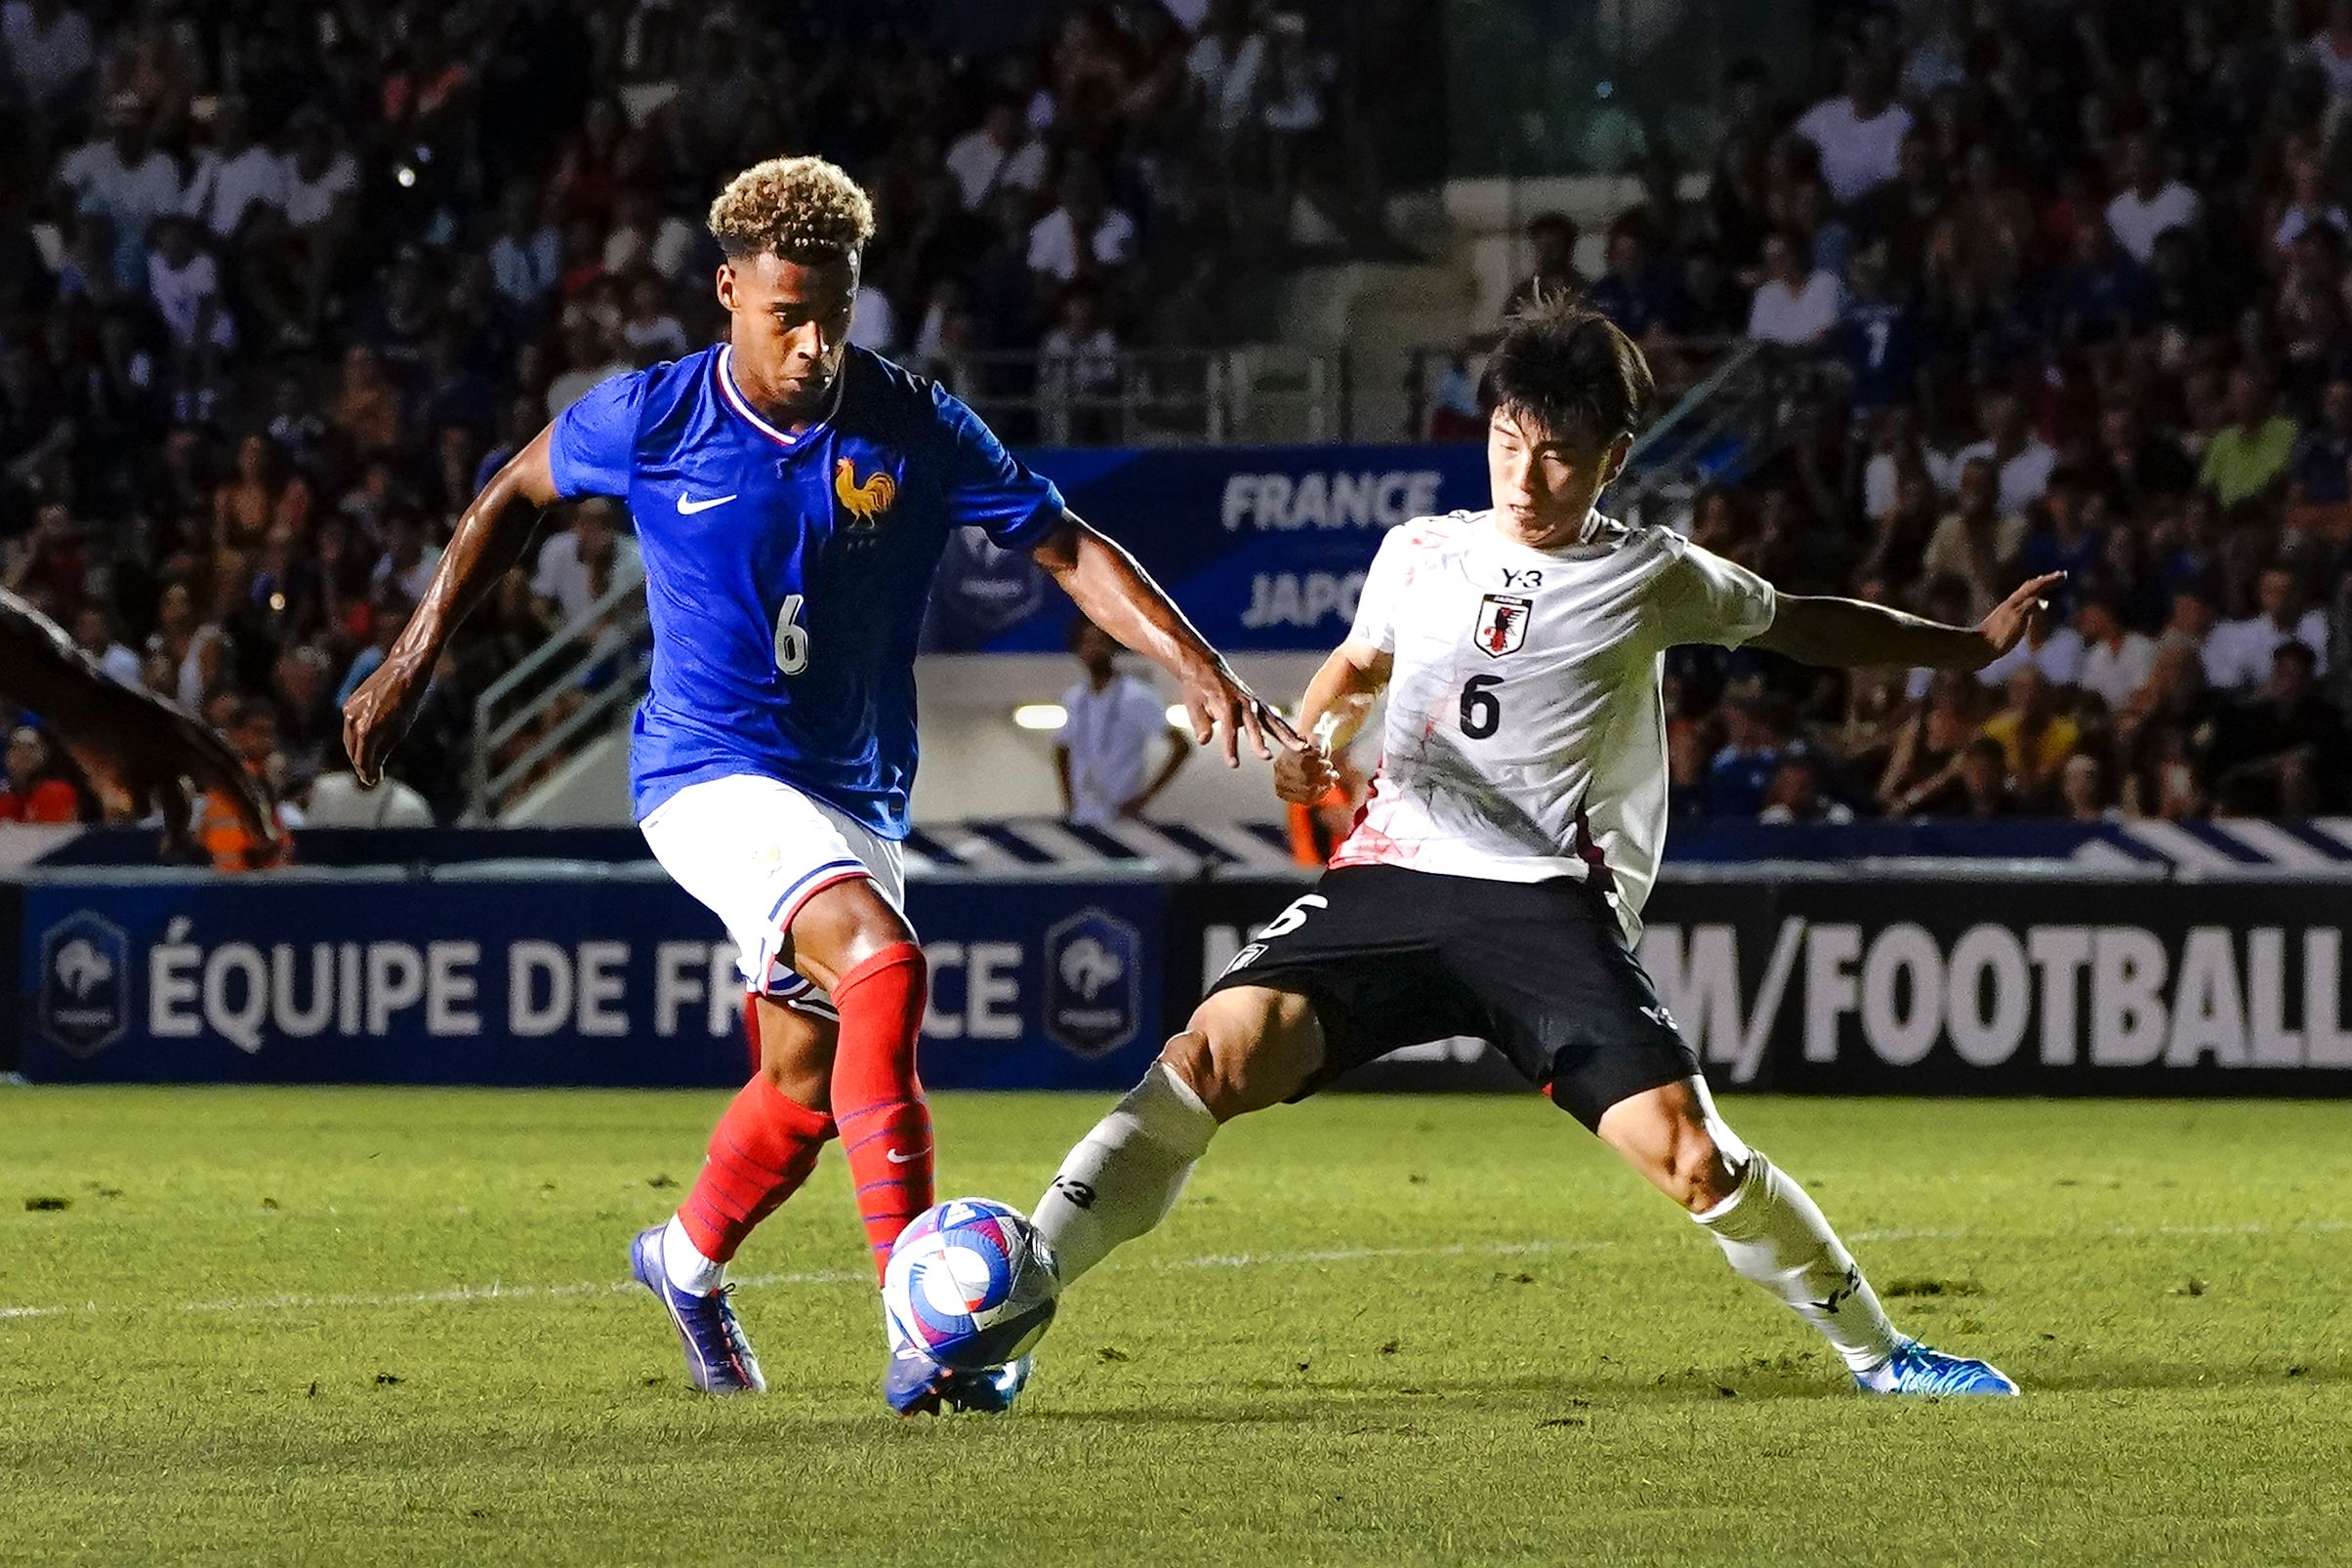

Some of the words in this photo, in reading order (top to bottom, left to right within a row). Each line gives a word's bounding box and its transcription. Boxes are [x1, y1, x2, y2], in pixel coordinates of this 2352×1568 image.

[1220, 471, 1443, 532] FRANCE
[1240, 570, 1369, 629] JAP
[1502, 567, 1543, 588] Y-3
[774, 594, 809, 676] 6
[1460, 674, 1505, 740] 6
[1257, 893, 1329, 939] 6
[148, 916, 481, 1053] ÉQUIPE
[508, 941, 630, 1037] DE
[654, 940, 1023, 1039] FRCE
